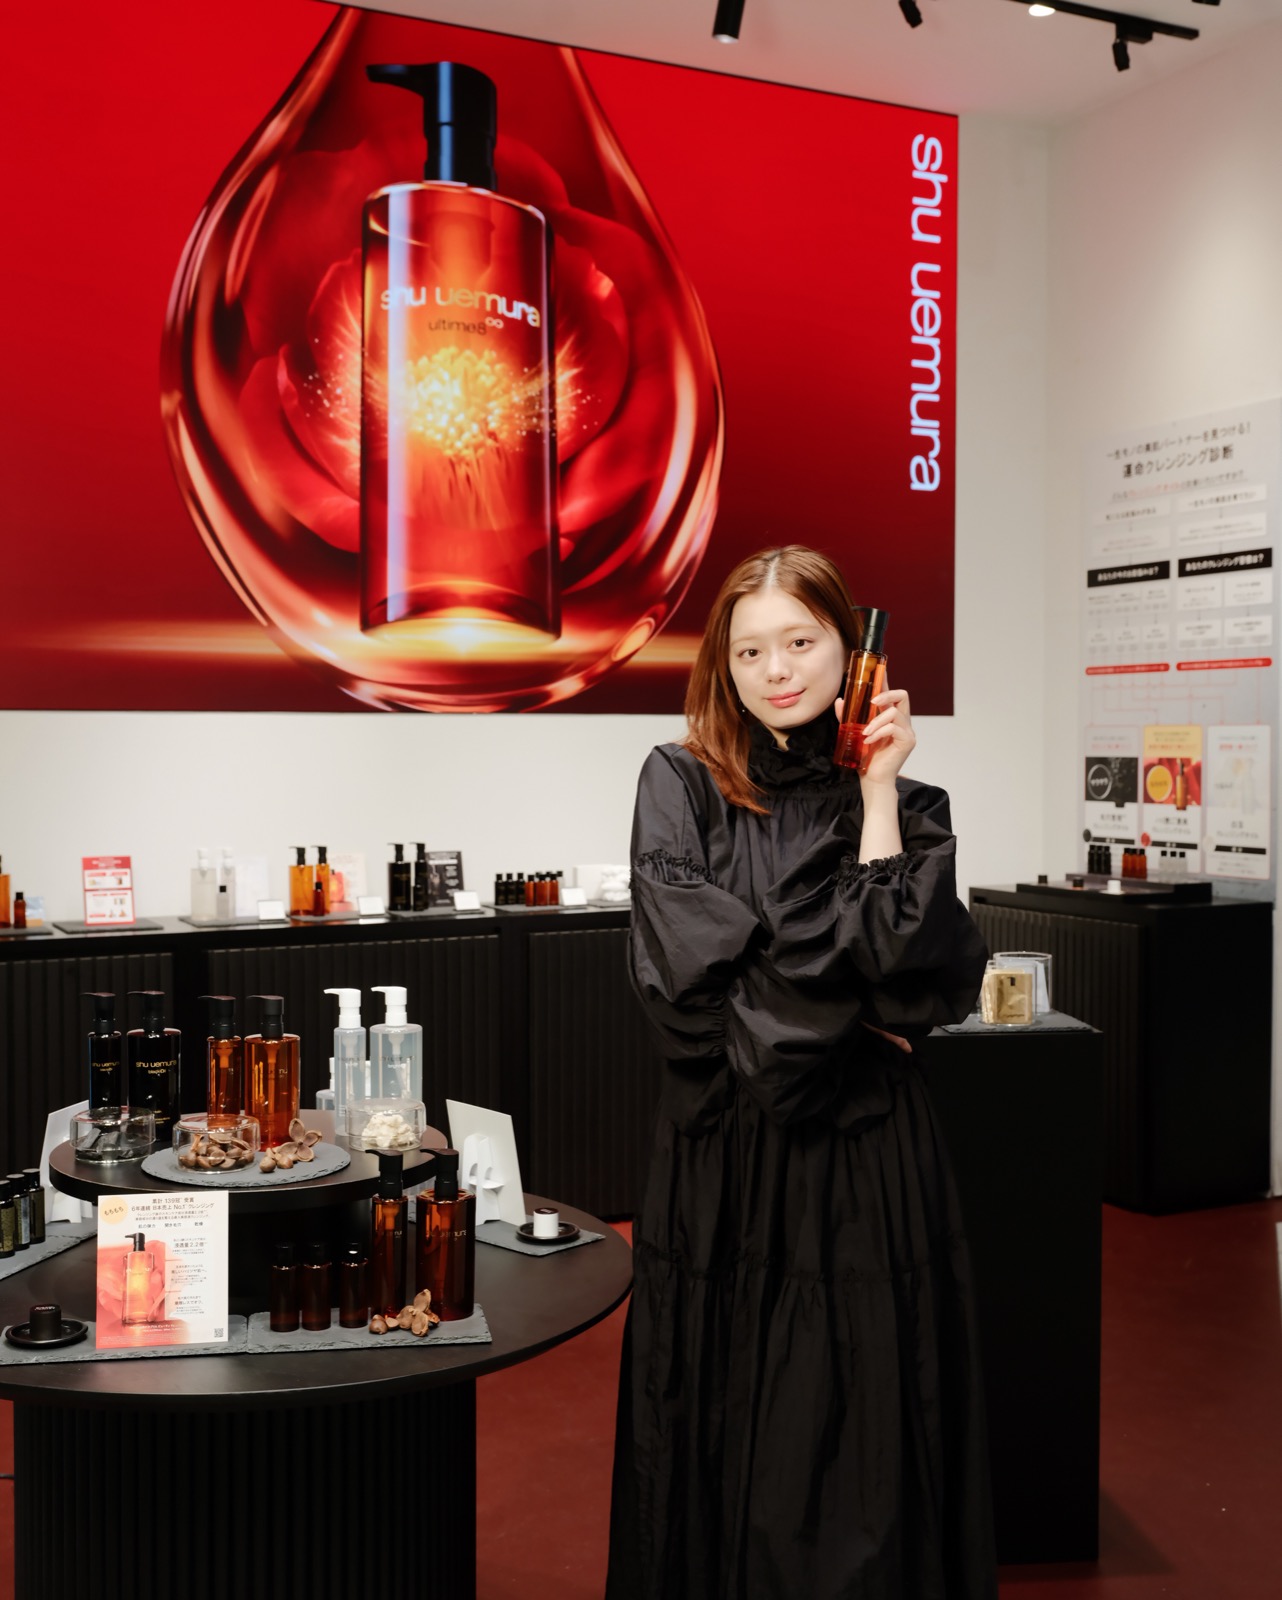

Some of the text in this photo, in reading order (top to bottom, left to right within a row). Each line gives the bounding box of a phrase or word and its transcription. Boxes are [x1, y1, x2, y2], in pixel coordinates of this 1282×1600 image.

[380, 285, 541, 328] shu uemura
[909, 133, 949, 492] shu uemura
[1123, 443, 1234, 479] 運命クレンジング診断
[135, 1059, 177, 1068] shu uemura
[104, 1205, 125, 1217] もちもち
